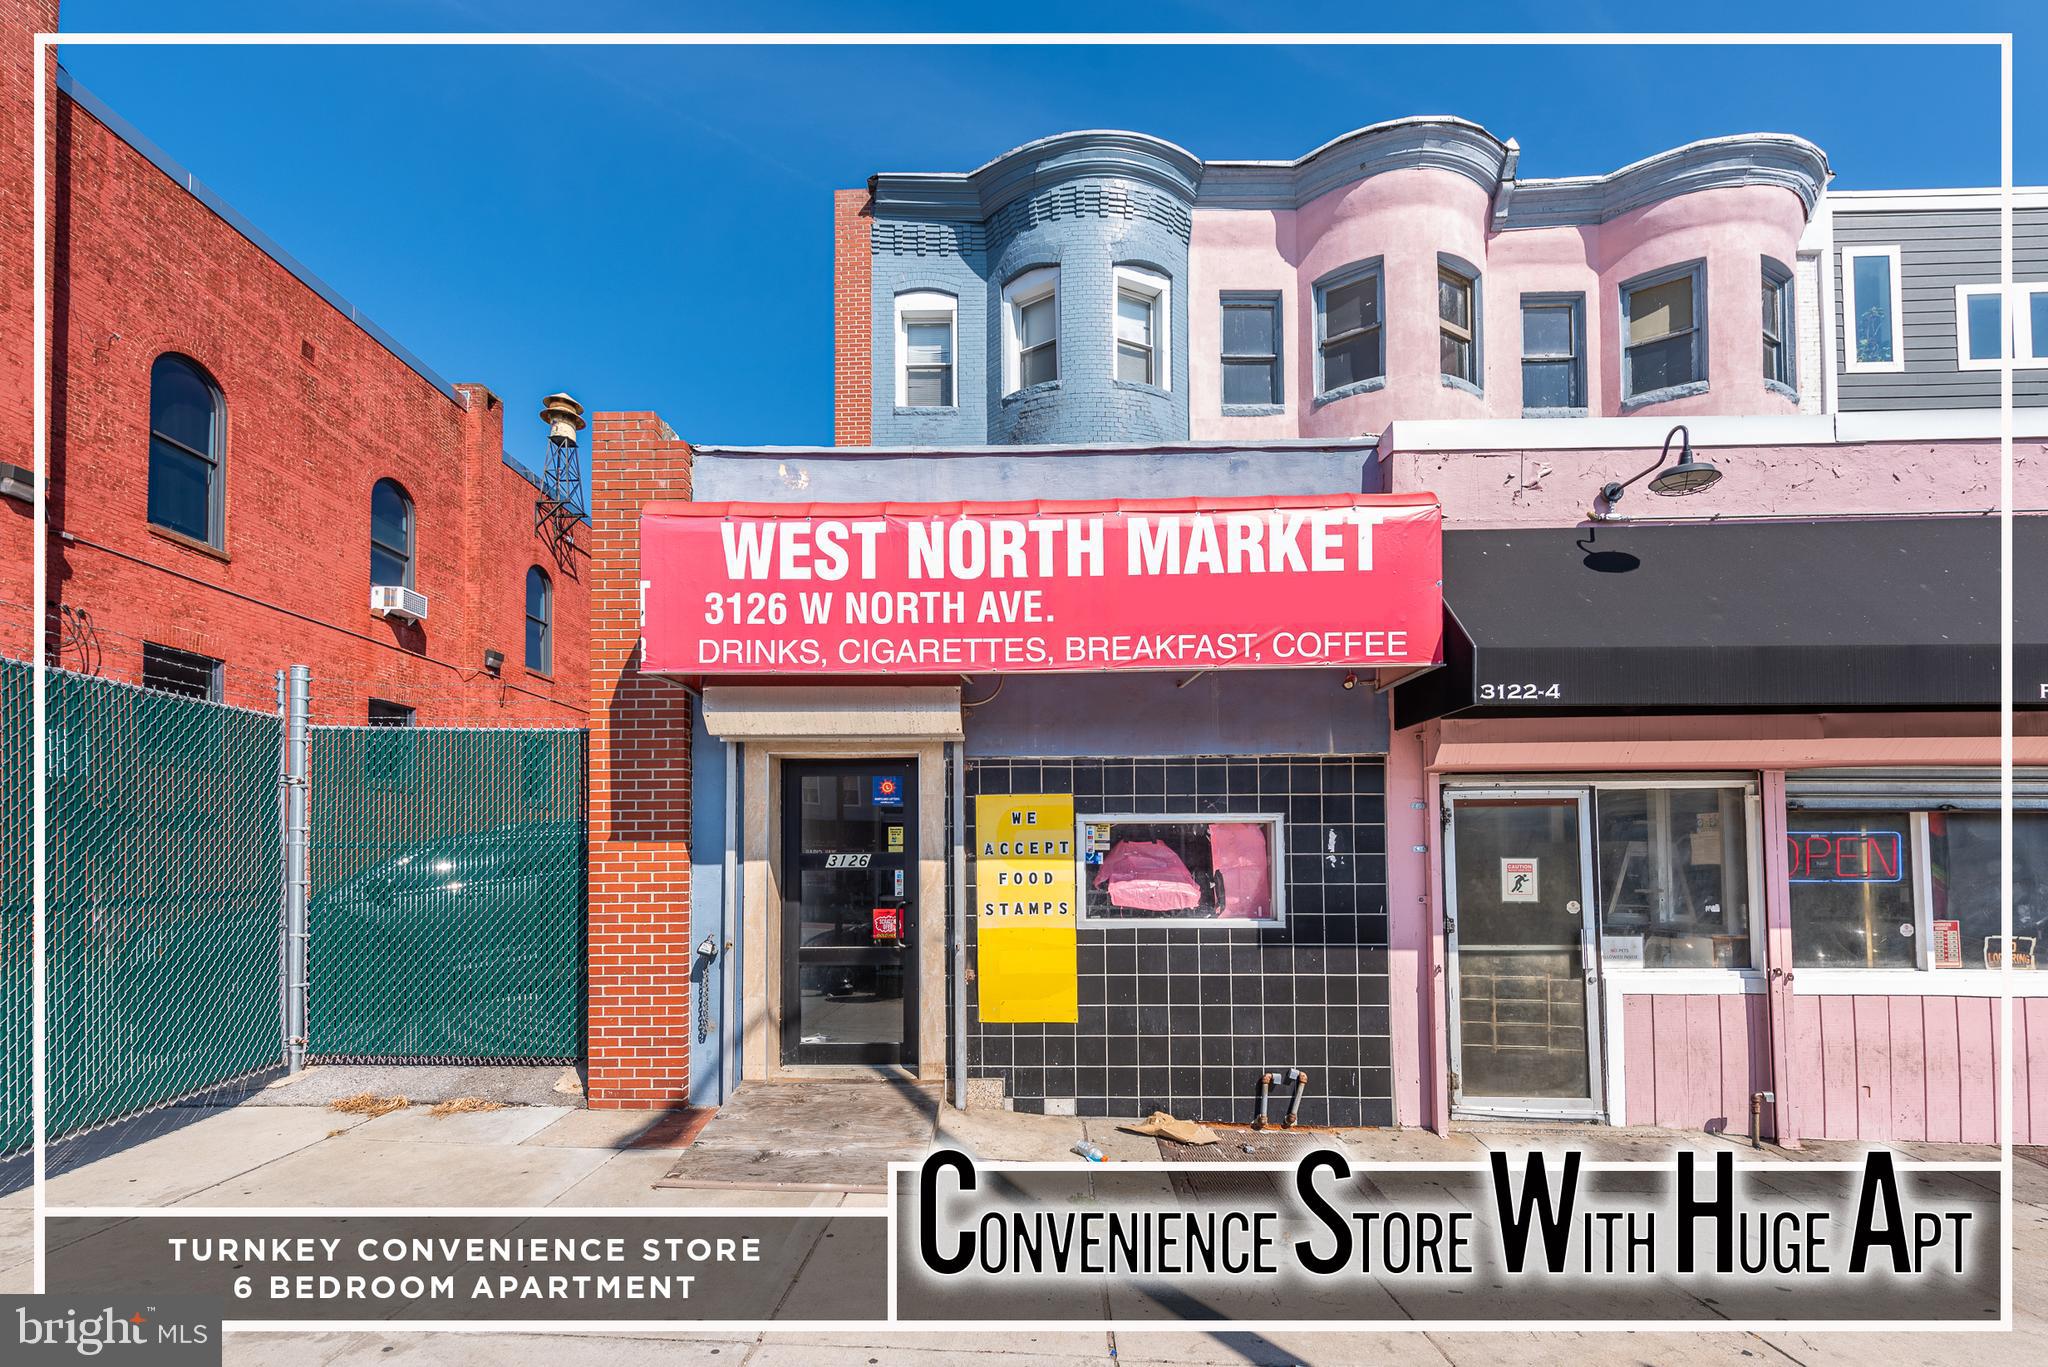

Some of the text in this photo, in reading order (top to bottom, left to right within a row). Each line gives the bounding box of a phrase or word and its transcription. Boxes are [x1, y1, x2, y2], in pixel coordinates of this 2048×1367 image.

[721, 514, 1383, 580] WEST NORTH MARKET
[705, 591, 1053, 624] 3126 W NORTH AVE.
[700, 631, 1407, 668] DRINKS, CIGARETTES, BREAKFAST, COFFEE
[1480, 683, 1561, 700] 3122-4
[1011, 811, 1036, 825] WE
[984, 841, 1069, 856] ACCEPT
[828, 855, 869, 867] 3126
[999, 872, 1053, 885] FOOD
[985, 902, 1067, 916] STAMPS
